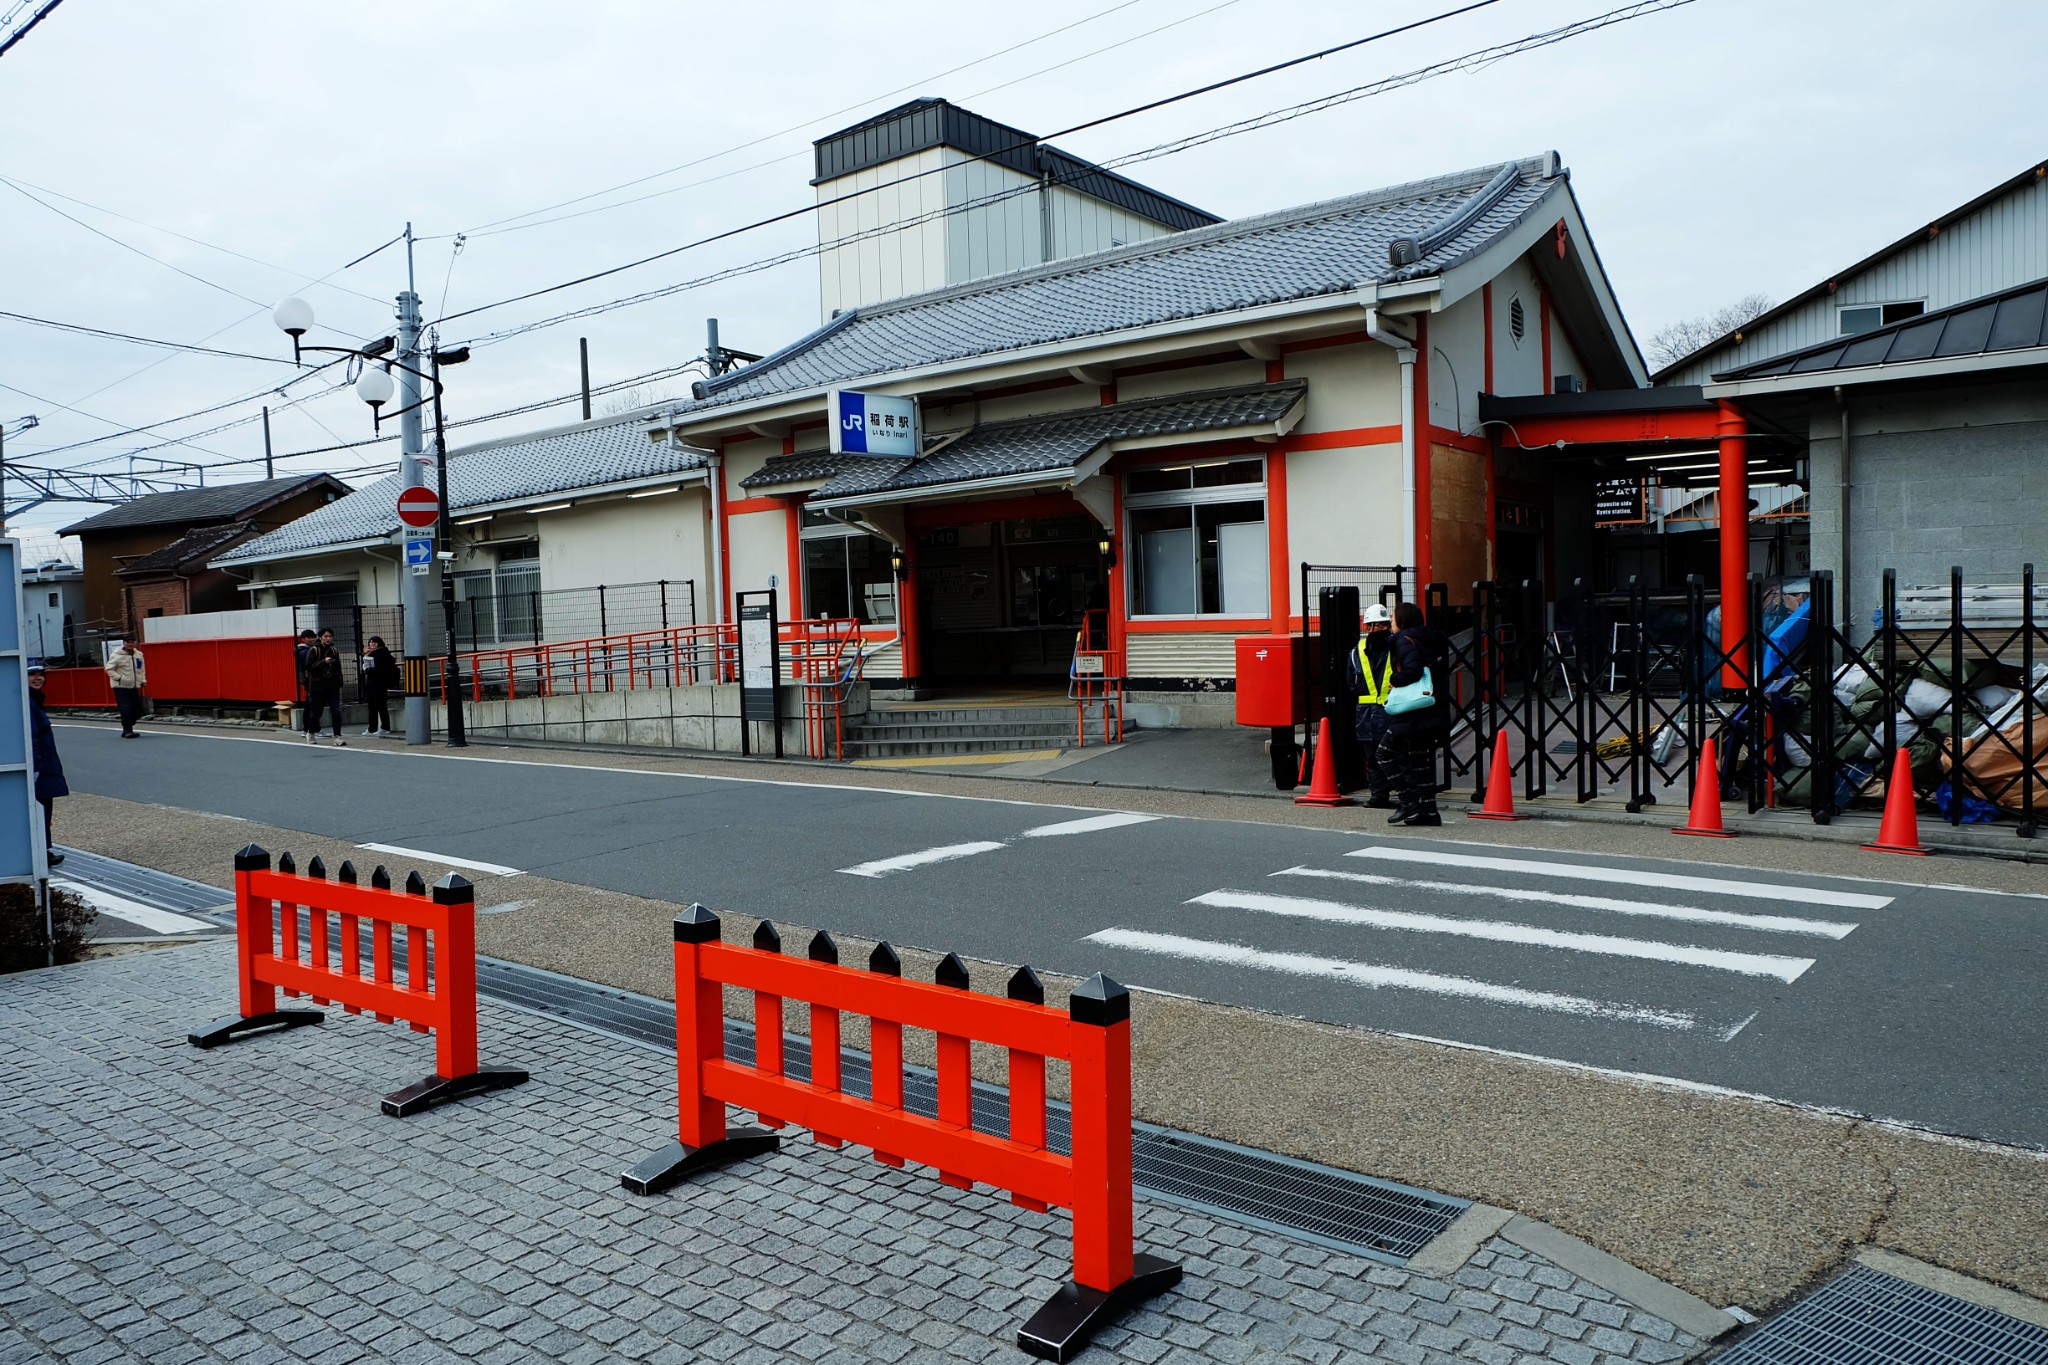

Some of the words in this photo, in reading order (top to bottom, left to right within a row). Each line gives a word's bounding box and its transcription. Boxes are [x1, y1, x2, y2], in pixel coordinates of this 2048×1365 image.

[842, 414, 863, 431] JR
[870, 413, 909, 428] 稲荷駅
[872, 429, 890, 437] いなり
[893, 430, 908, 439] Inari
